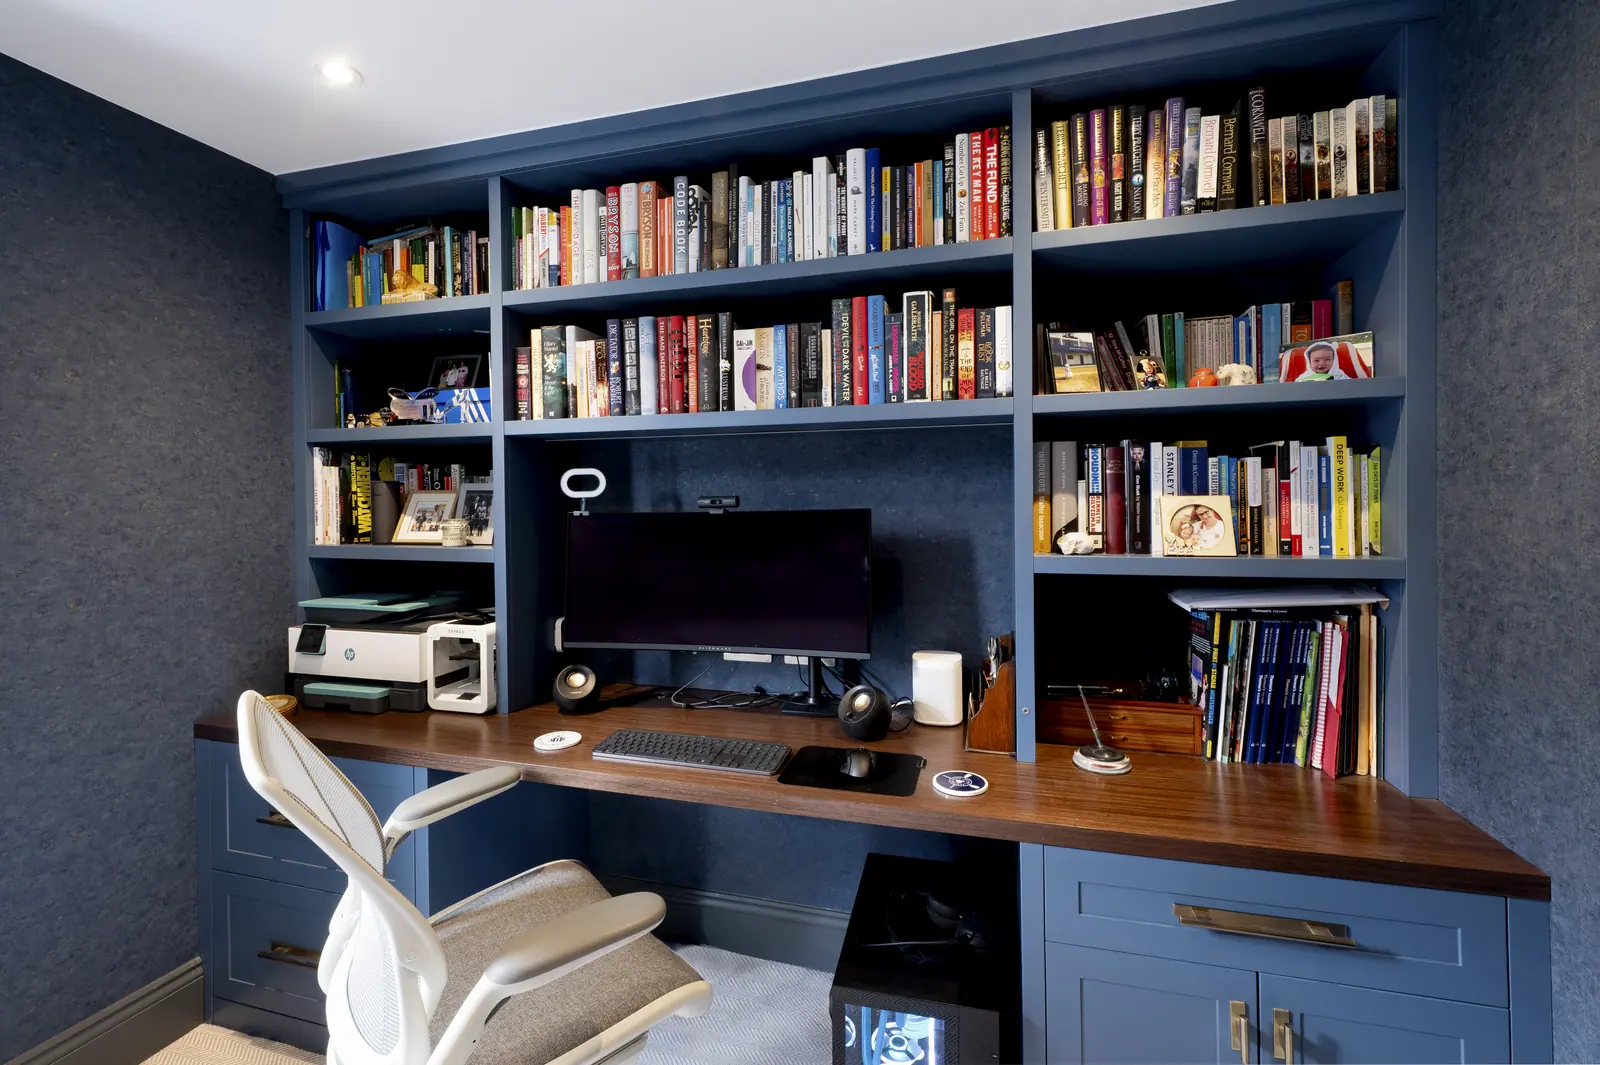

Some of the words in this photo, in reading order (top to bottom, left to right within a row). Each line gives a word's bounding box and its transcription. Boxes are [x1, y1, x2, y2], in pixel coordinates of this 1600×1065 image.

[1133, 116, 1142, 135] TERRY
[1223, 117, 1236, 154] Bernard
[1251, 94, 1265, 143] CORNWELL
[972, 135, 981, 154] THE
[1056, 125, 1065, 147] TERRY
[1204, 120, 1216, 154] Bernard
[959, 166, 965, 176] Go
[972, 158, 981, 177] KEY
[987, 144, 996, 168] THE
[1058, 150, 1067, 191] PRATCHETT
[1133, 137, 1141, 172] PRATCHETT
[958, 178, 965, 186] Up
[973, 180, 981, 202] MAN
[987, 170, 997, 203] FUND
[1204, 156, 1215, 193] Cornwell
[1221, 156, 1236, 195] Cornwell
[676, 183, 685, 216] CODE
[1041, 181, 1049, 228] WINTERSMITH
[608, 197, 618, 253] BRYSON
[642, 202, 651, 239] BRYSON
[676, 220, 685, 254] BOOK
[609, 324, 618, 360] DICTATOR
[949, 334, 954, 343] ON
[909, 356, 917, 390] BLOOD
